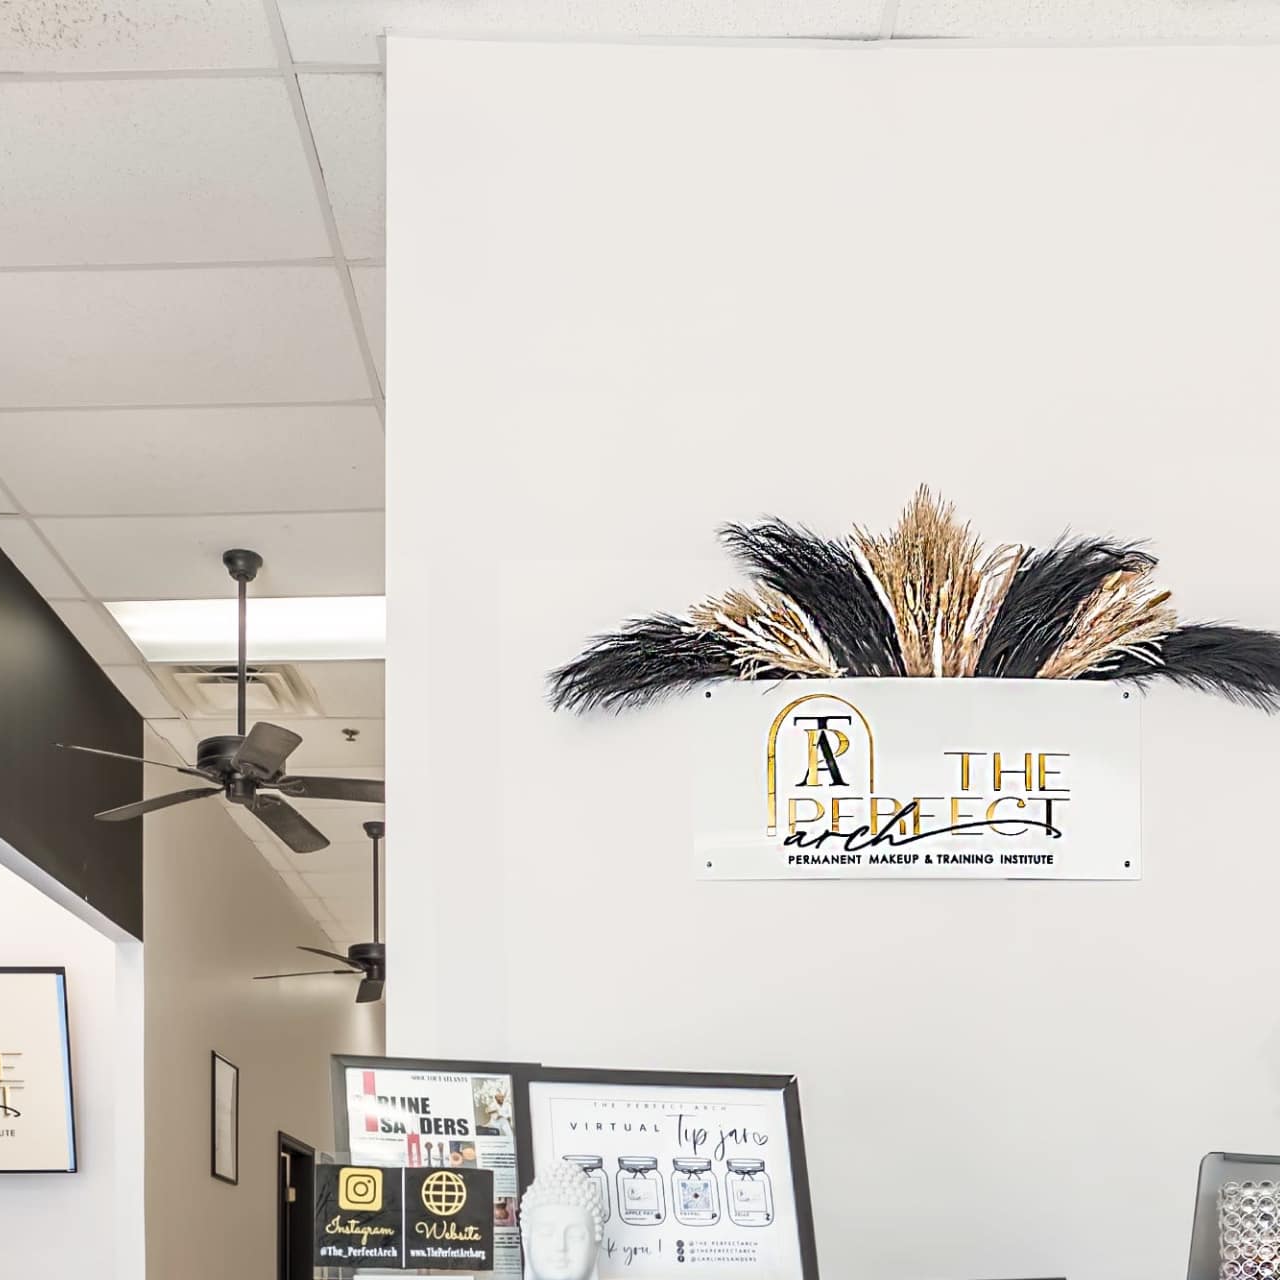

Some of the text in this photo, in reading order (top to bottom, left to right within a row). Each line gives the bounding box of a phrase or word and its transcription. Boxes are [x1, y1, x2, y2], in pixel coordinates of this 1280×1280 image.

[944, 752, 1070, 792] THE
[788, 797, 1070, 836] PERFECT
[788, 854, 1054, 865] PERMANENT MAKEUP & TRAINING INSTITUTE
[381, 1118, 469, 1136] SADERS
[571, 1122, 660, 1133] VIRTUAL
[665, 1113, 748, 1161] Tip jar
[325, 1215, 394, 1245] Instagram
[415, 1221, 482, 1241] Website
